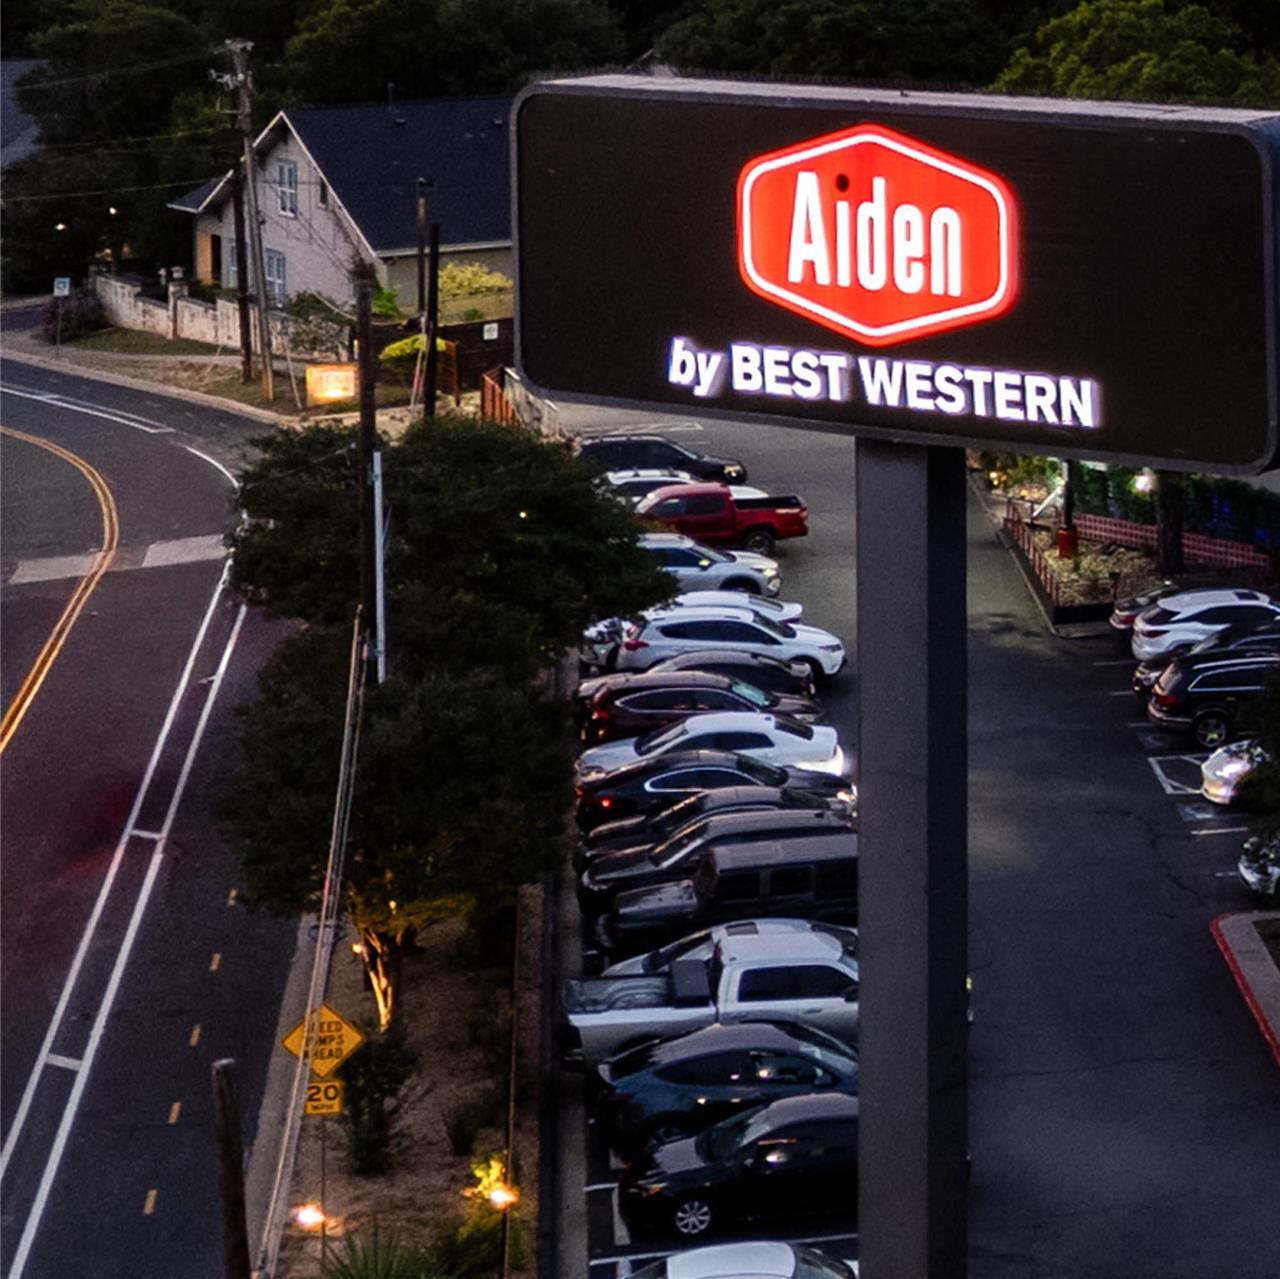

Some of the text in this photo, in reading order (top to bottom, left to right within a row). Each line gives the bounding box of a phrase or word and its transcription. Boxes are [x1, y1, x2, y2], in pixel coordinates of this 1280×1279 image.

[787, 170, 963, 298] Aiden
[667, 334, 1098, 428] by BEST WESTERN
[306, 1020, 343, 1034] EED
[305, 1034, 344, 1047] MPS
[306, 1084, 338, 1102] 20
